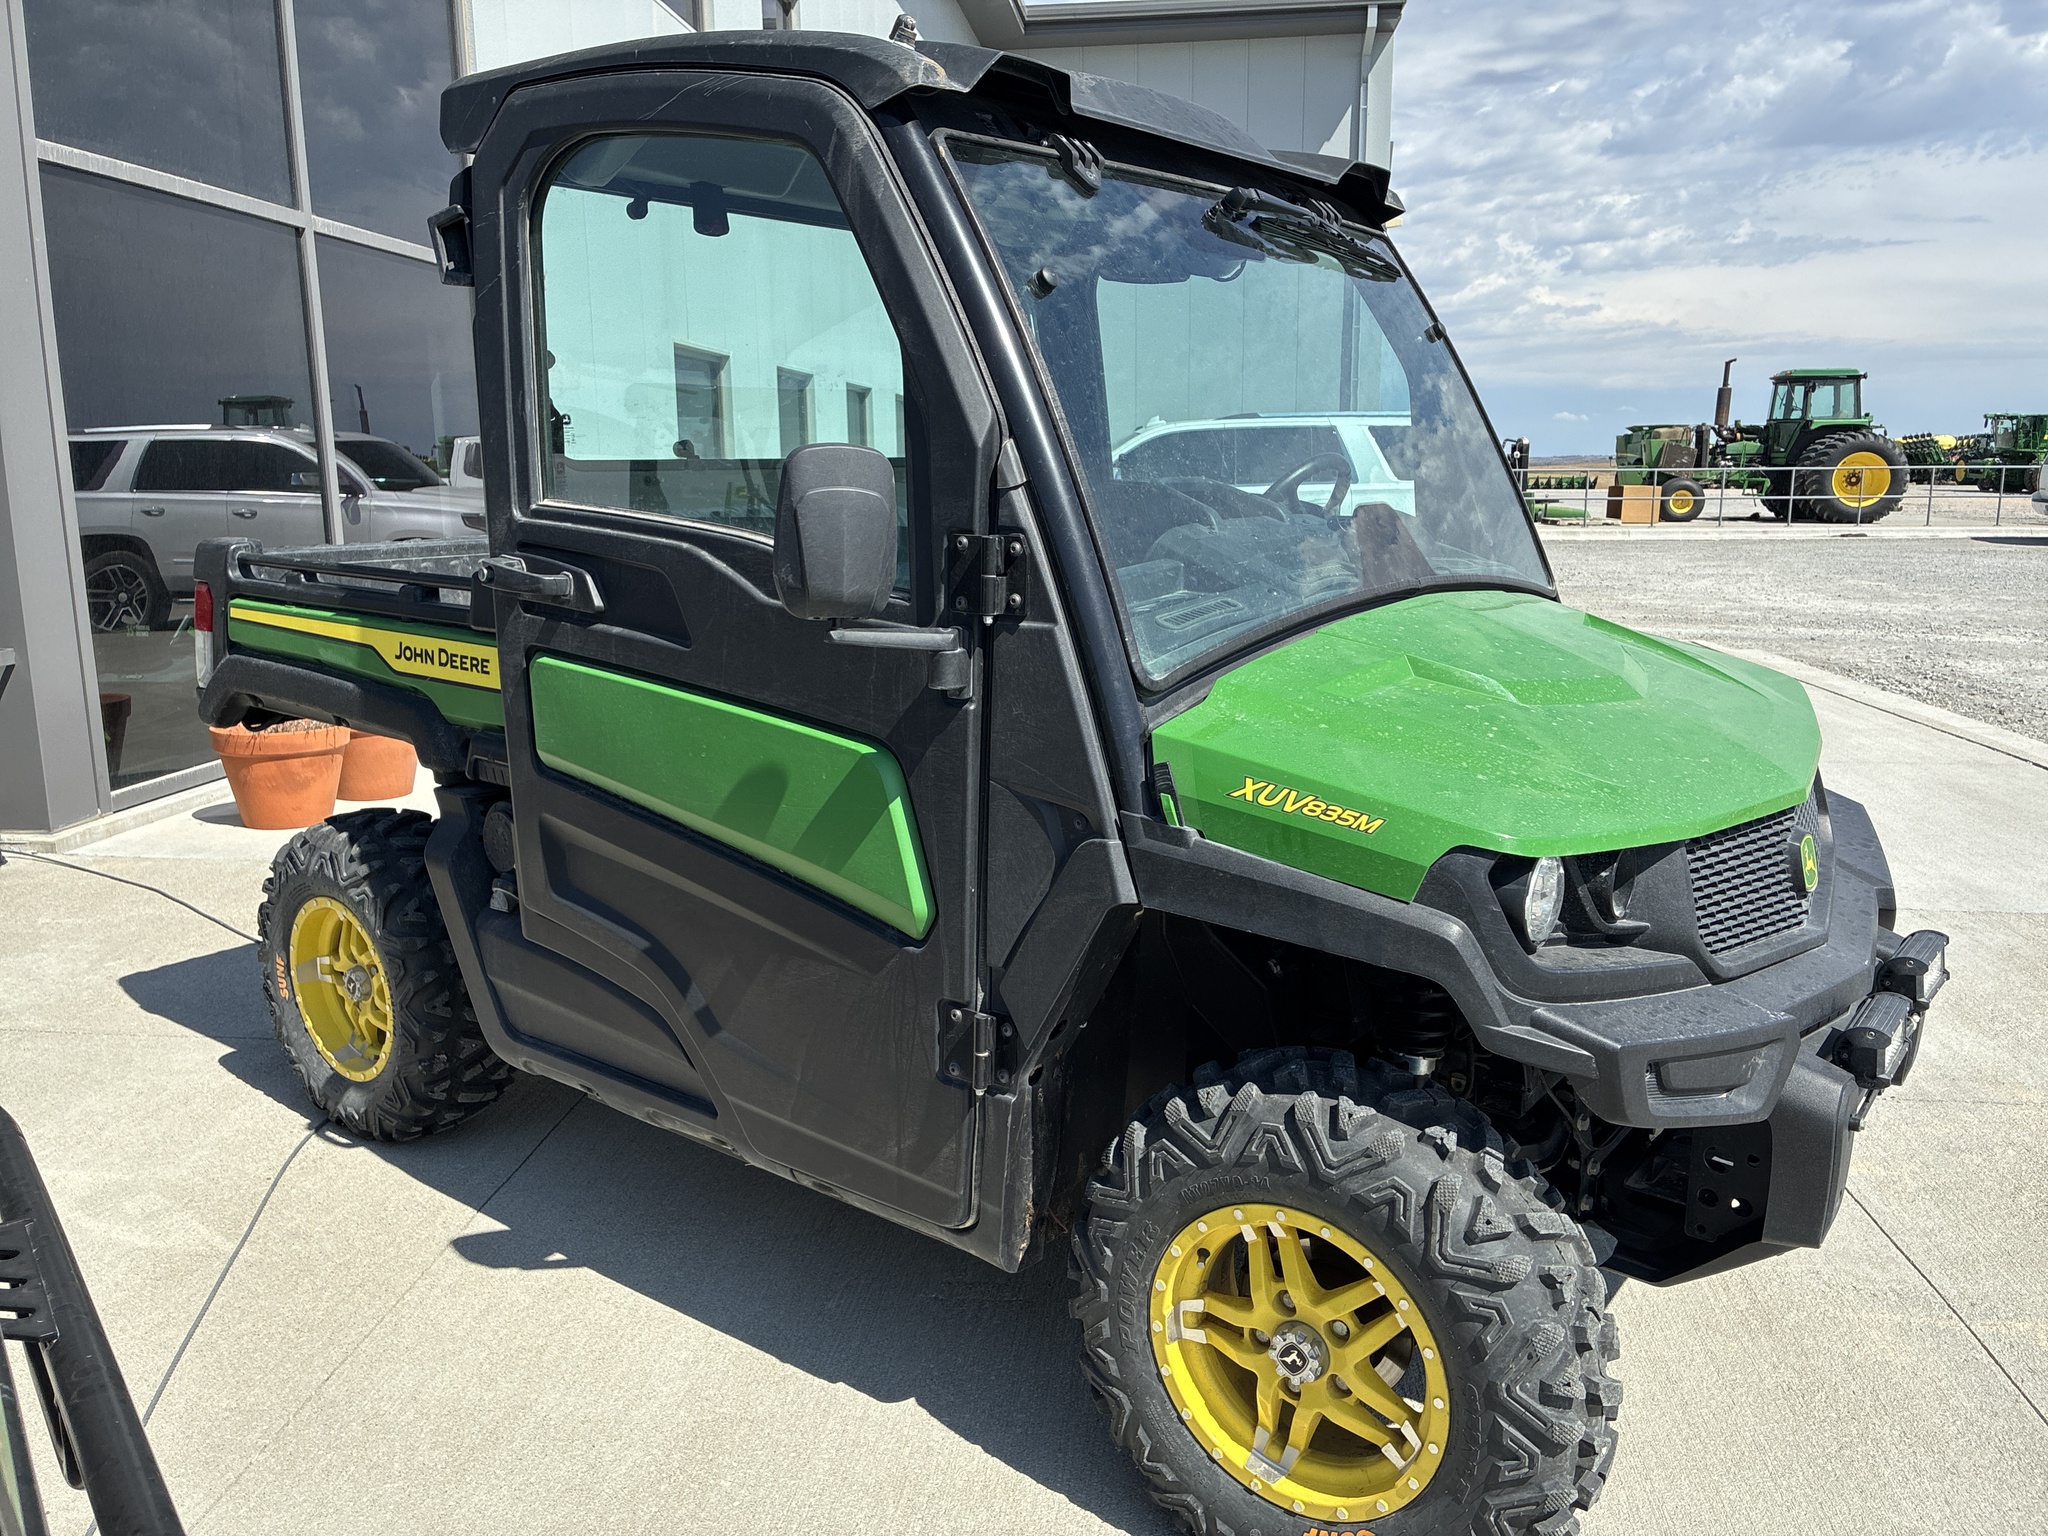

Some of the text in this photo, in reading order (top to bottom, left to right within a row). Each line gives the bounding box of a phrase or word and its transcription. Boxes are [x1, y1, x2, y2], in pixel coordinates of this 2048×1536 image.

[395, 641, 490, 675] JOHN DEERE
[1226, 776, 1387, 834] XUV835M
[1118, 1220, 1160, 1354] POWER
